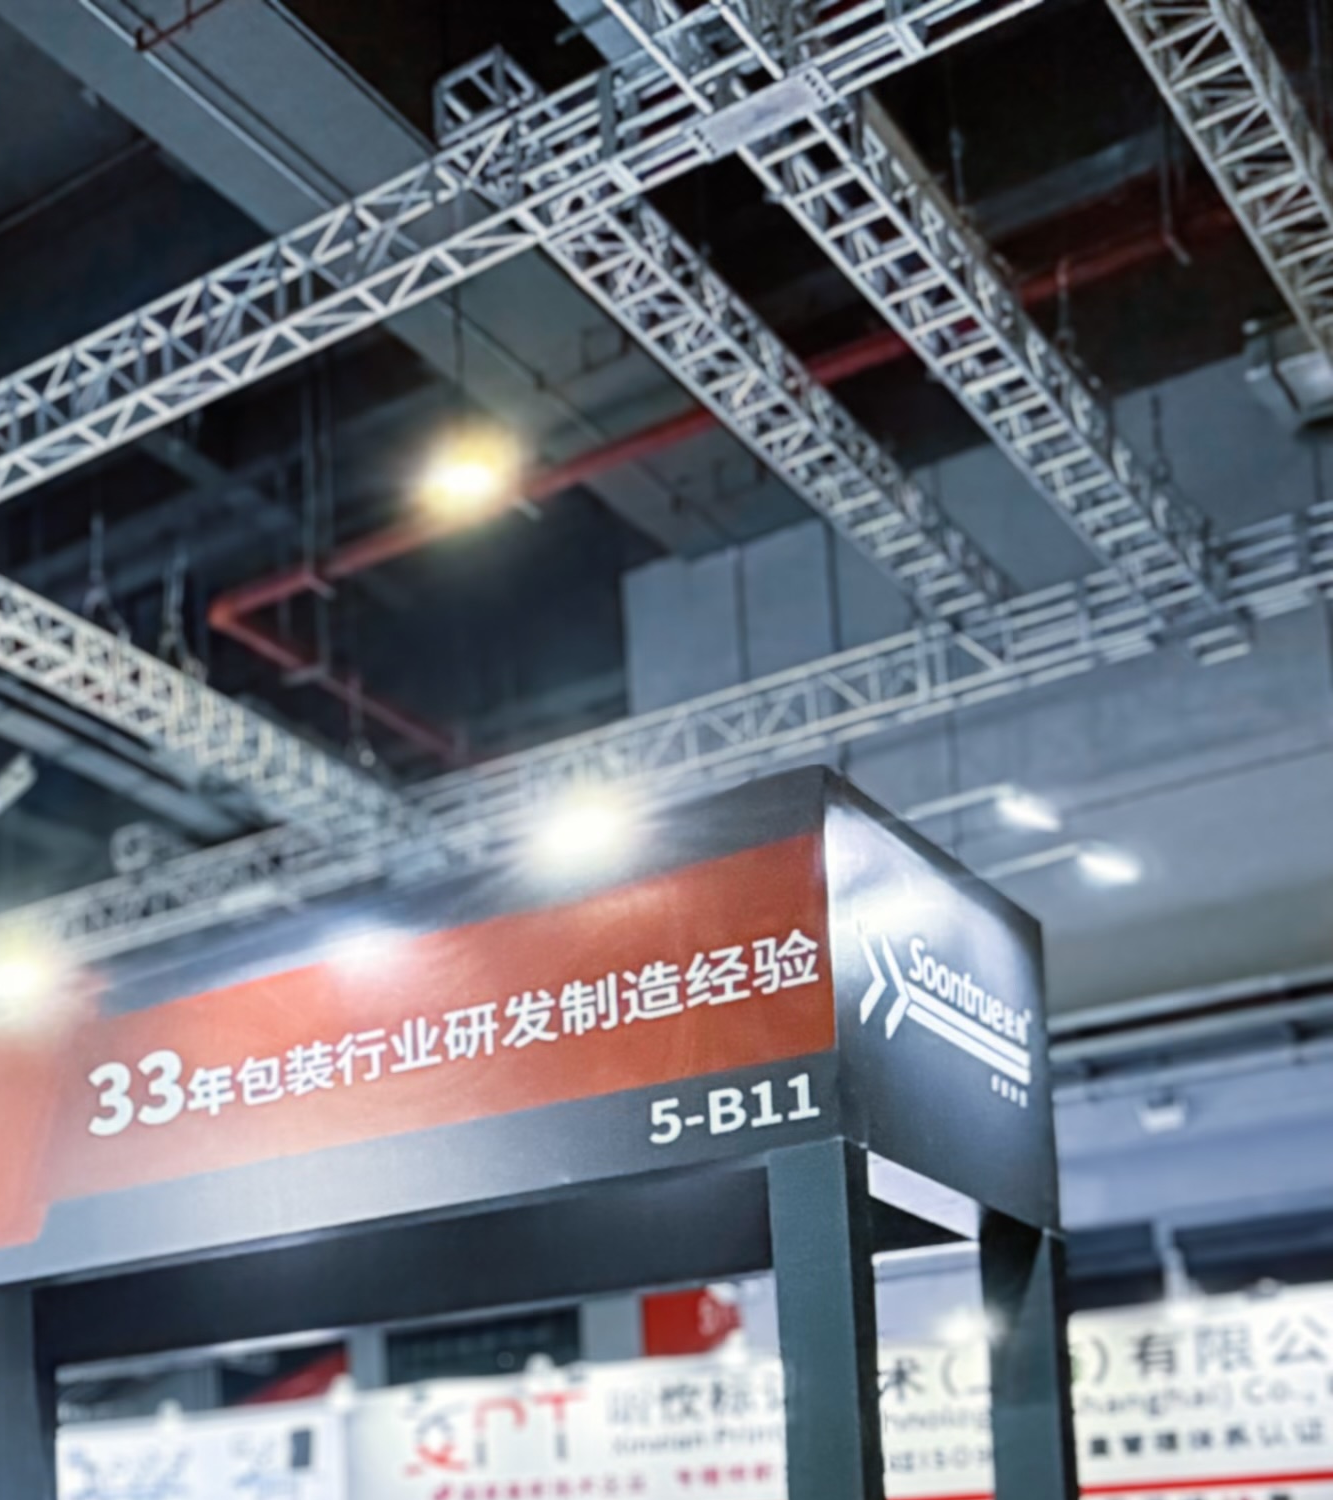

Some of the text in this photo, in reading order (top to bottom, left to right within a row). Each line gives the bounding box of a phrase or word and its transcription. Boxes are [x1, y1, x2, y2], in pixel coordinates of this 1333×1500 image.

[87, 928, 820, 1138] 33年包装行业研发制造经验
[907, 937, 1005, 1034] Soontrue
[648, 1072, 821, 1145] 5-B11
